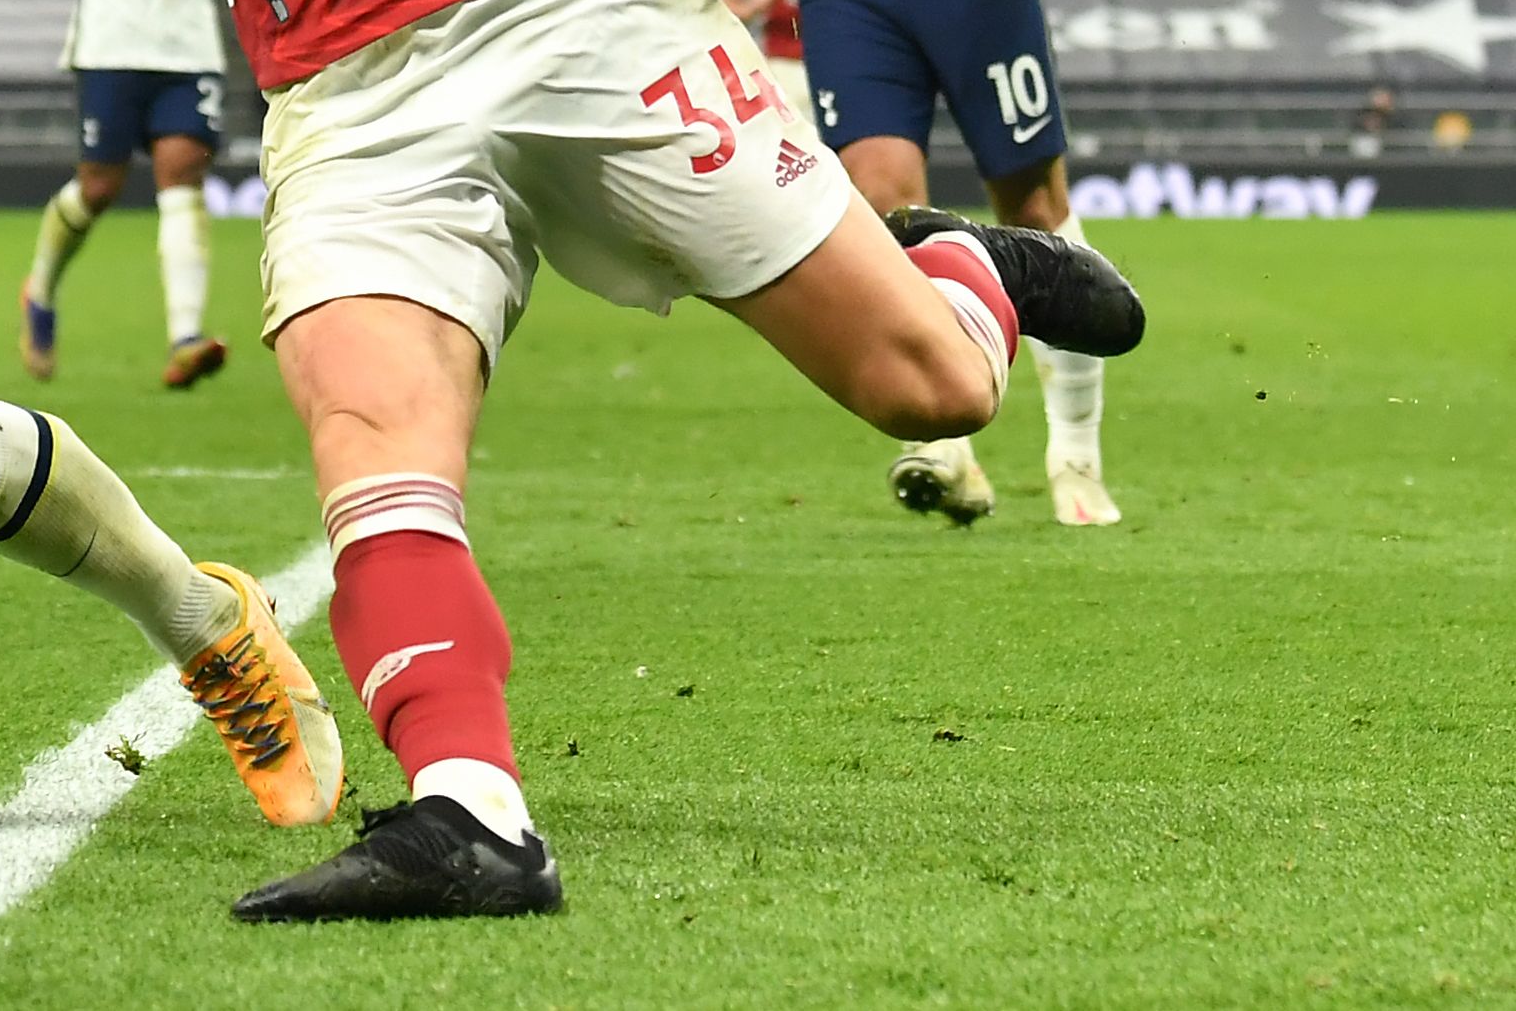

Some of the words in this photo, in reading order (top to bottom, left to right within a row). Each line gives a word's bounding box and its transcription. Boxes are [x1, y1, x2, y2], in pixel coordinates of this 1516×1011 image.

[639, 44, 796, 175] 34
[986, 54, 1049, 126] 10
[1069, 162, 1378, 219] etway
